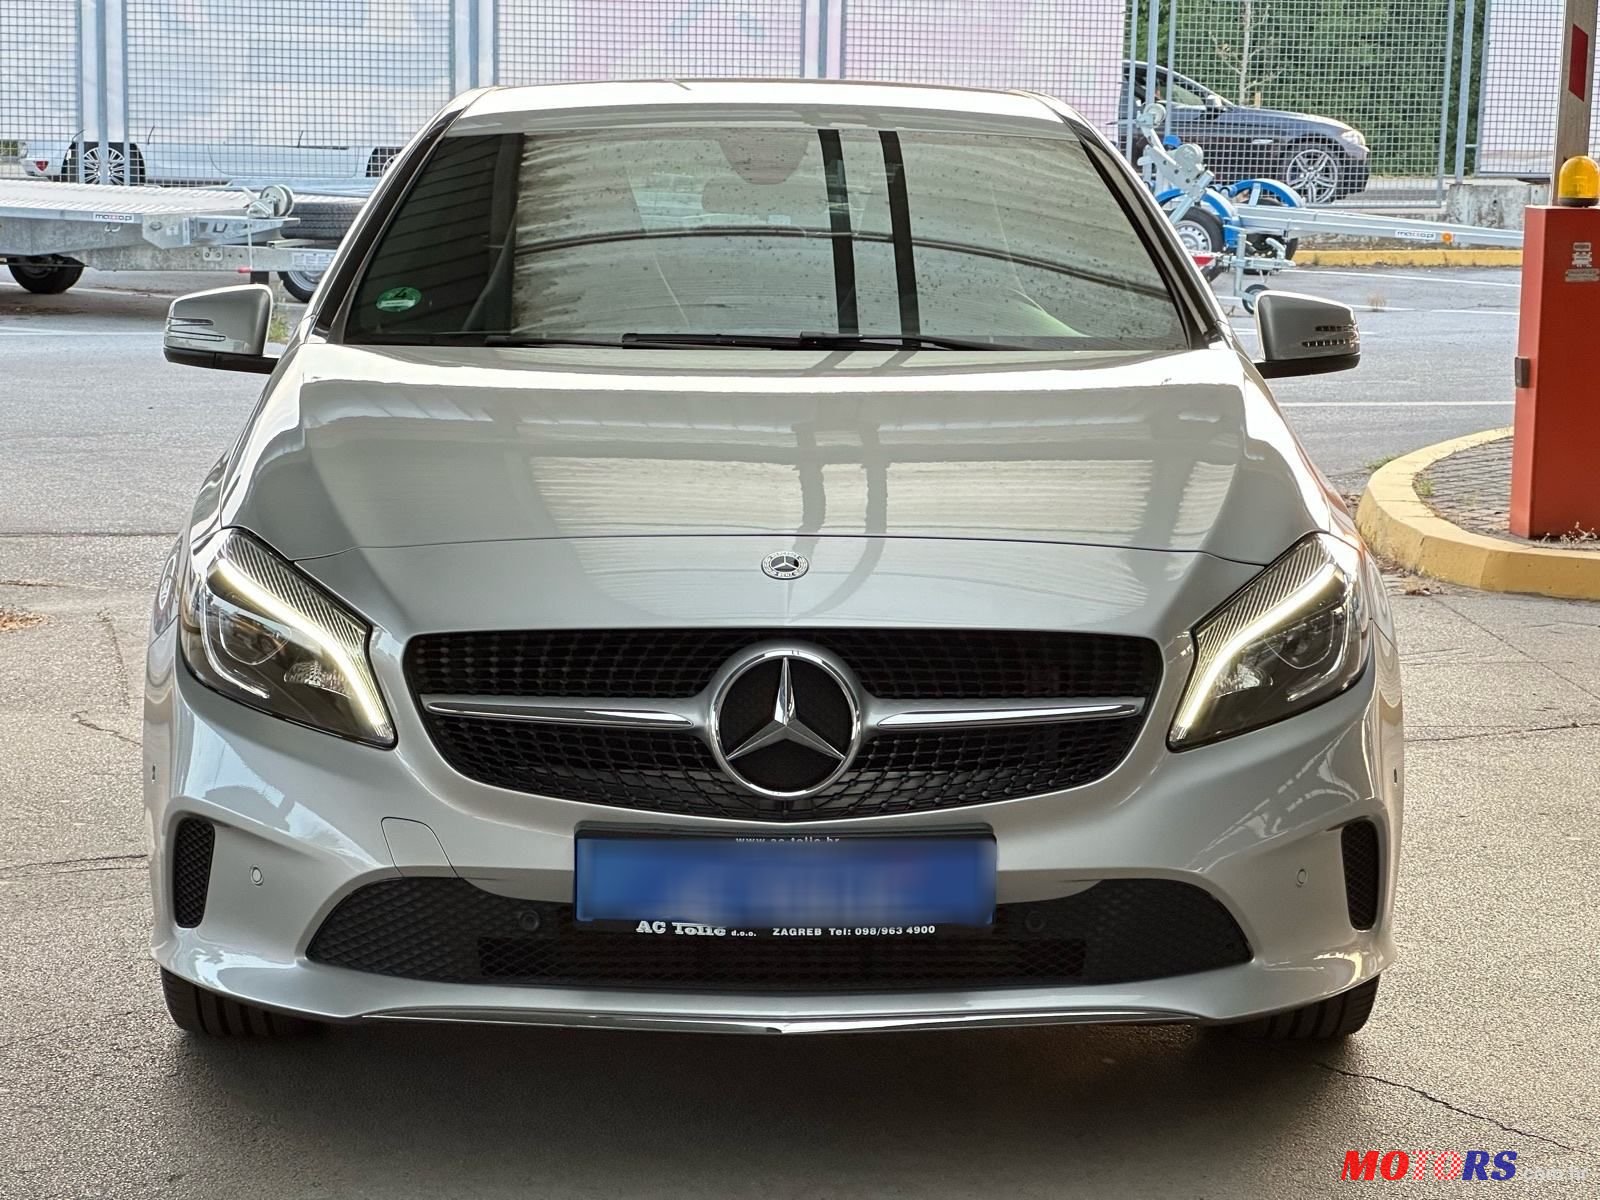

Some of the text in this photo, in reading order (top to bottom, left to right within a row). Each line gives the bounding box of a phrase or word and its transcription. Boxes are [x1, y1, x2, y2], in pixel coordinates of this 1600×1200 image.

[635, 920, 667, 934] AC
[730, 929, 758, 937] d.o.o.
[772, 927, 822, 936] ZAGREB
[828, 927, 852, 936] Tel:
[854, 926, 903, 937] 098/963
[906, 925, 936, 935] 4900
